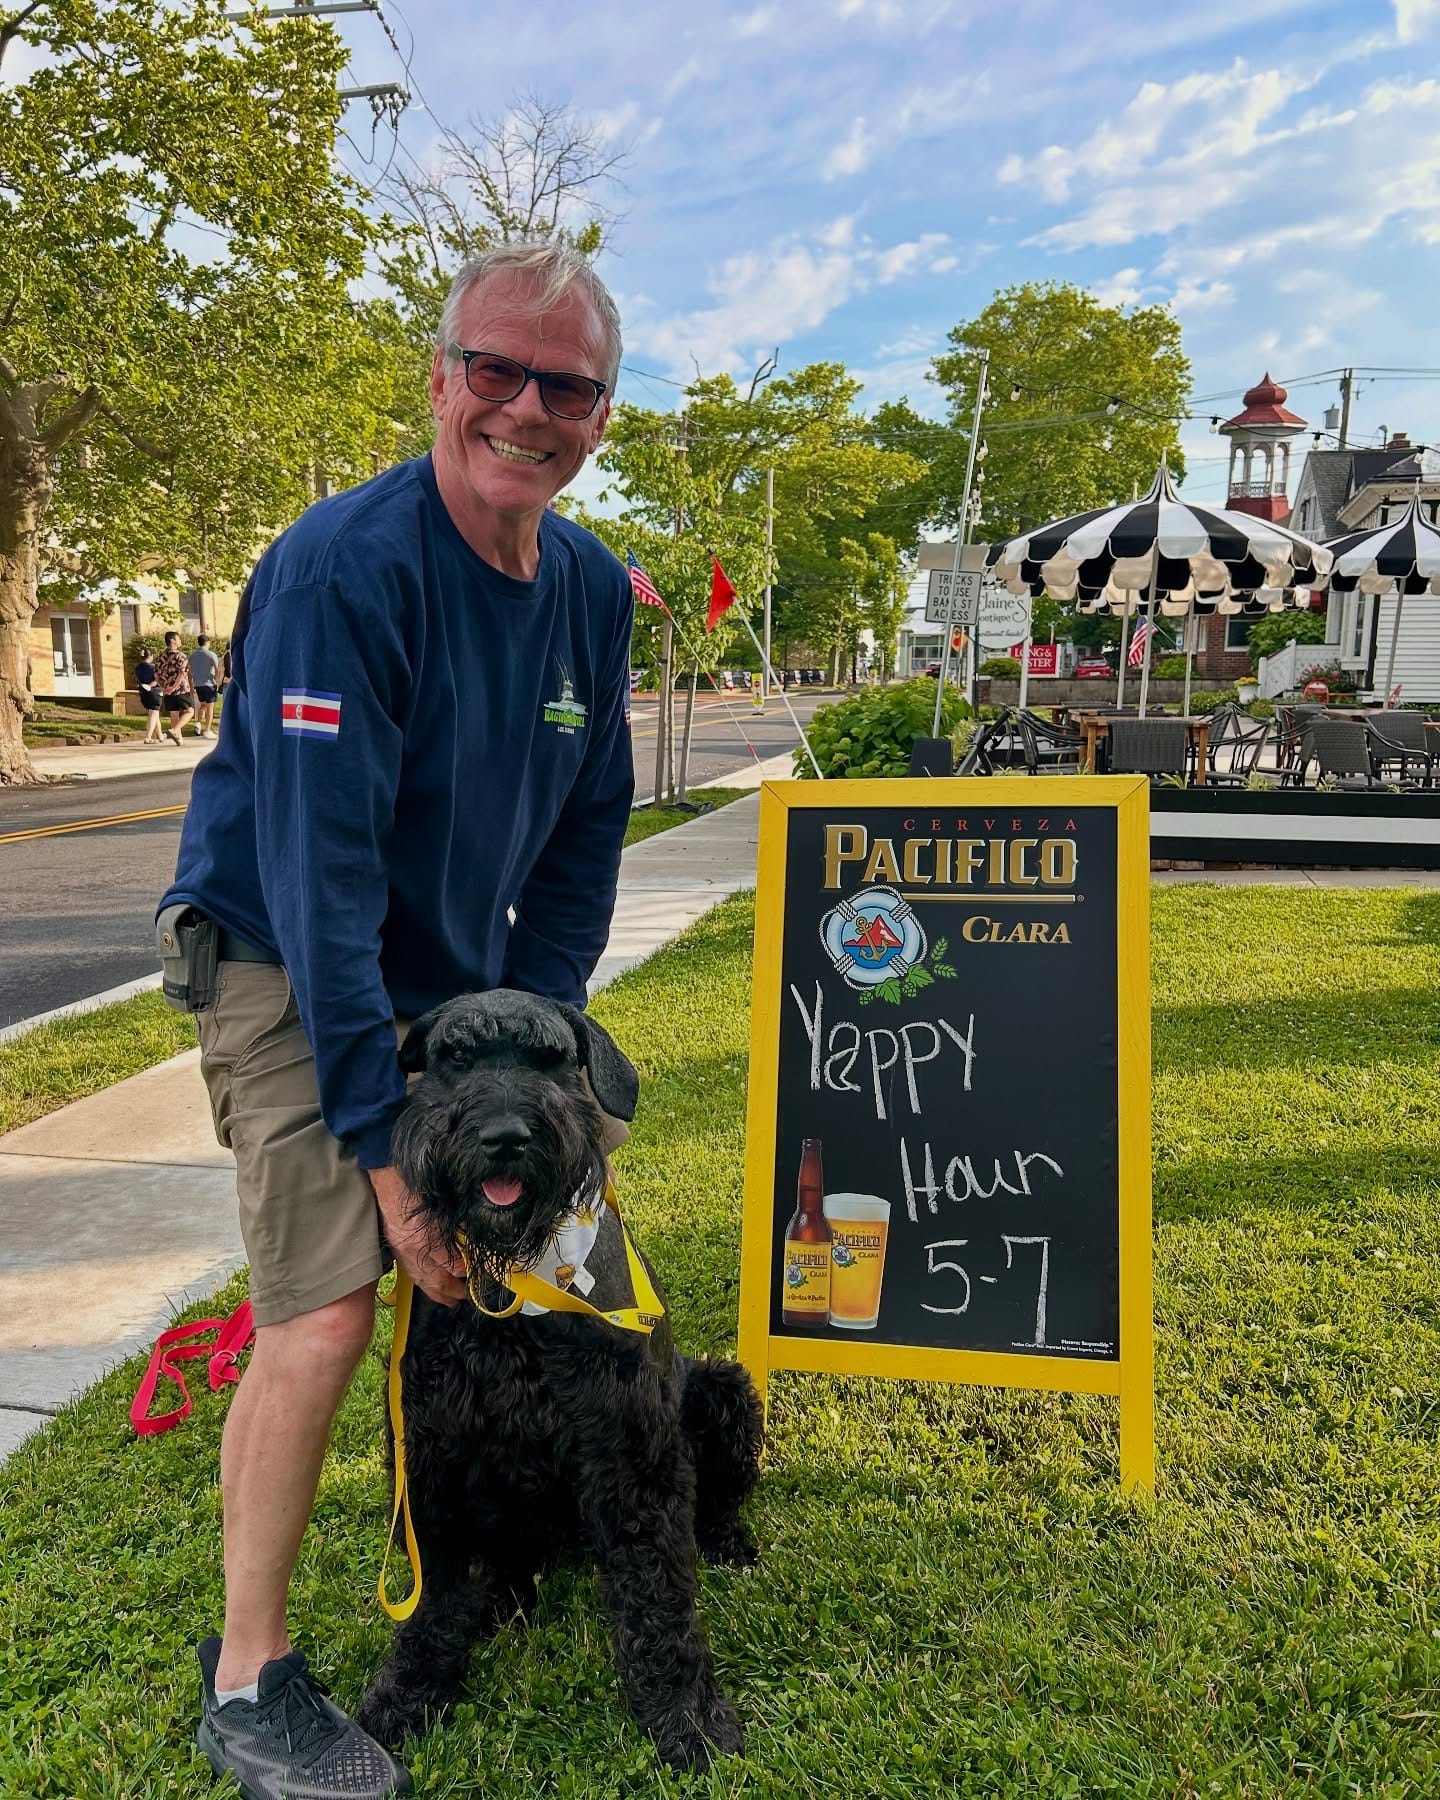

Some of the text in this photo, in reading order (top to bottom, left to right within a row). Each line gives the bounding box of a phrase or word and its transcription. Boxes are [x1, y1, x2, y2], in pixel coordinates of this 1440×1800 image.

[939, 586, 950, 596] TO
[961, 599, 973, 609] ST
[978, 613, 1011, 623] outique
[1044, 648, 1053, 657] &
[903, 819, 1077, 831] CERVEZA
[823, 824, 1079, 889] PACIFICO
[962, 916, 1072, 944] CLARA
[901, 1137, 1064, 1223] Hour
